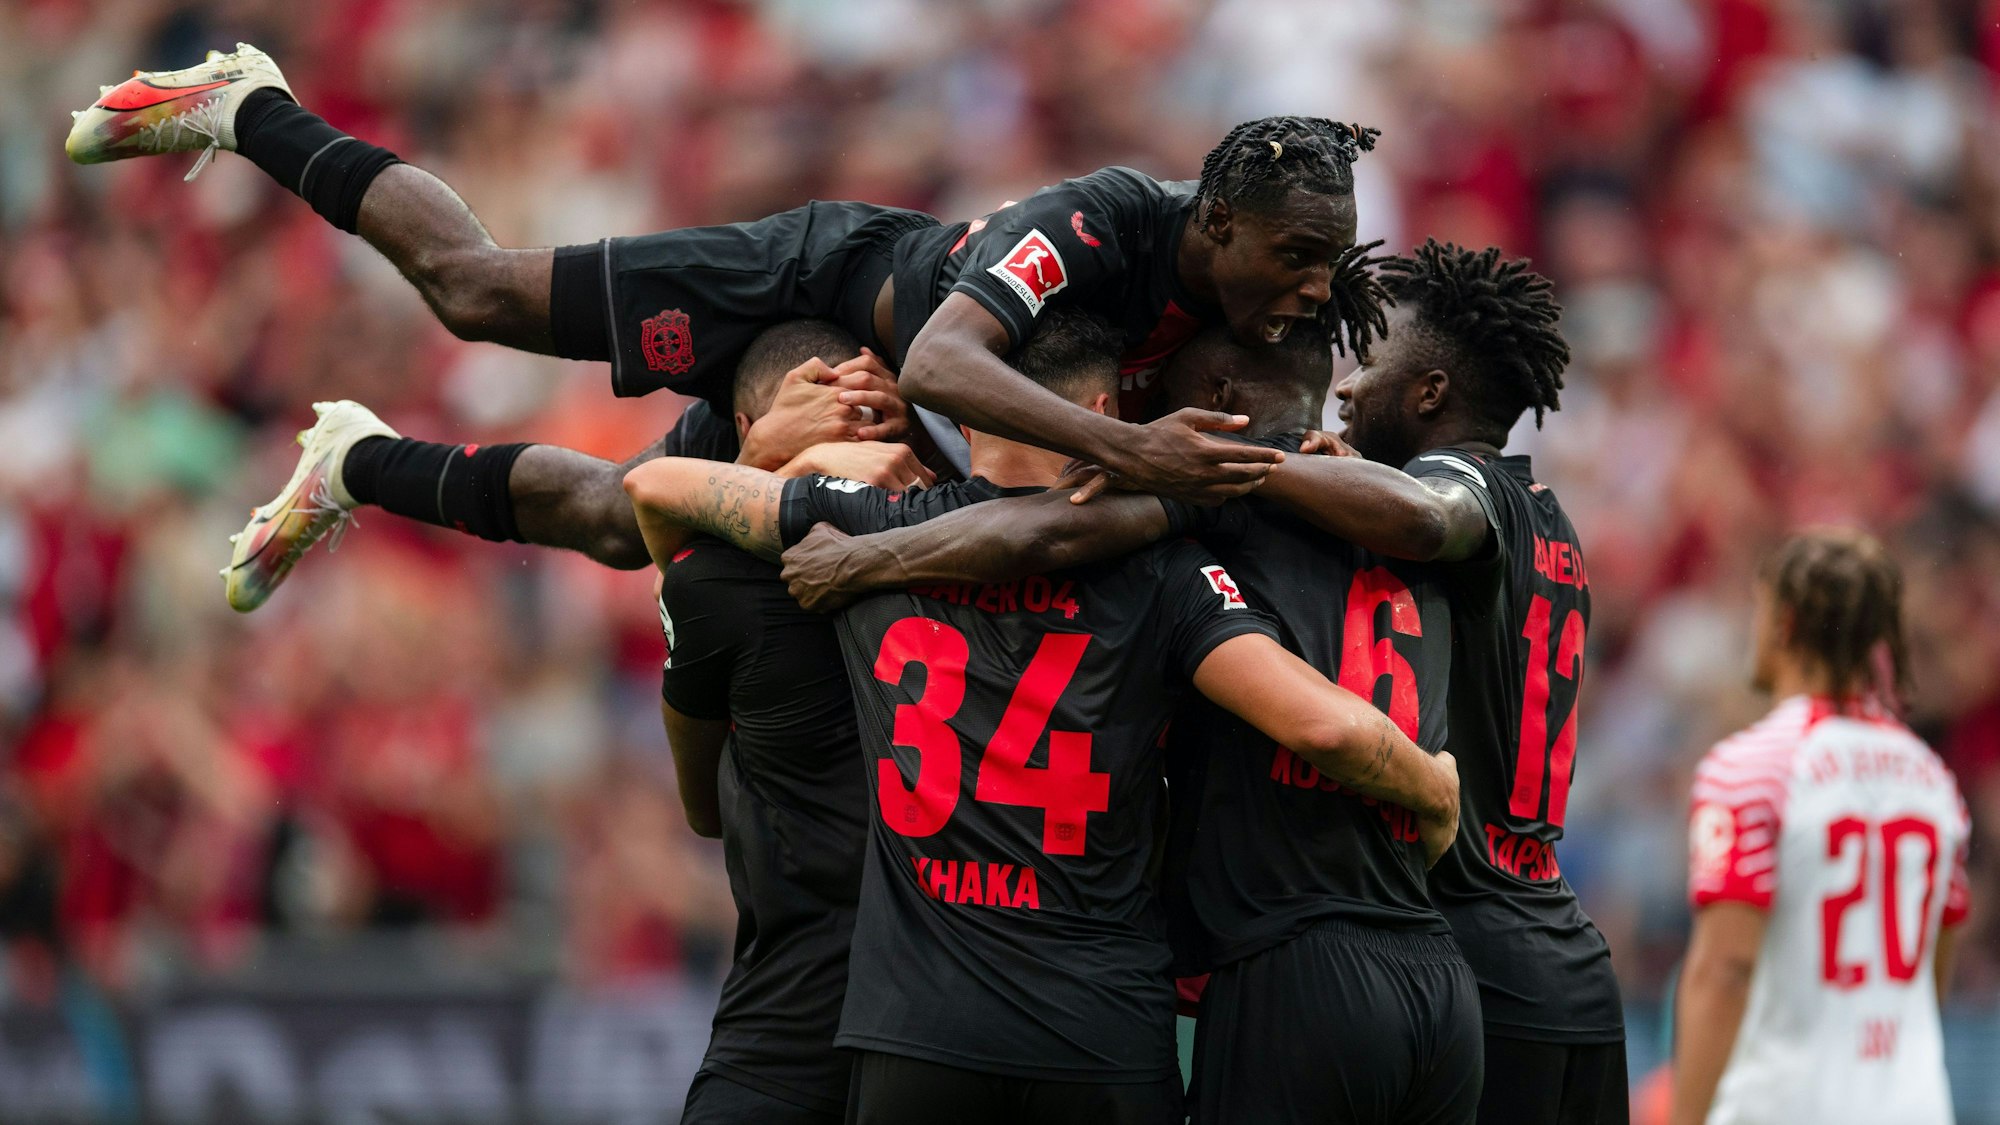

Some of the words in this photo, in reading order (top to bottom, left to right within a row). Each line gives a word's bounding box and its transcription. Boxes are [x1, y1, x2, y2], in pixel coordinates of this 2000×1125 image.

[995, 268, 1037, 311] BUNDESLIGA
[1024, 575, 1080, 620] 04
[1337, 565, 1422, 745] 6
[874, 617, 1110, 855] 34
[1509, 594, 1588, 828] 12
[911, 857, 1040, 909] XHAKA
[1821, 816, 1938, 988] 20
